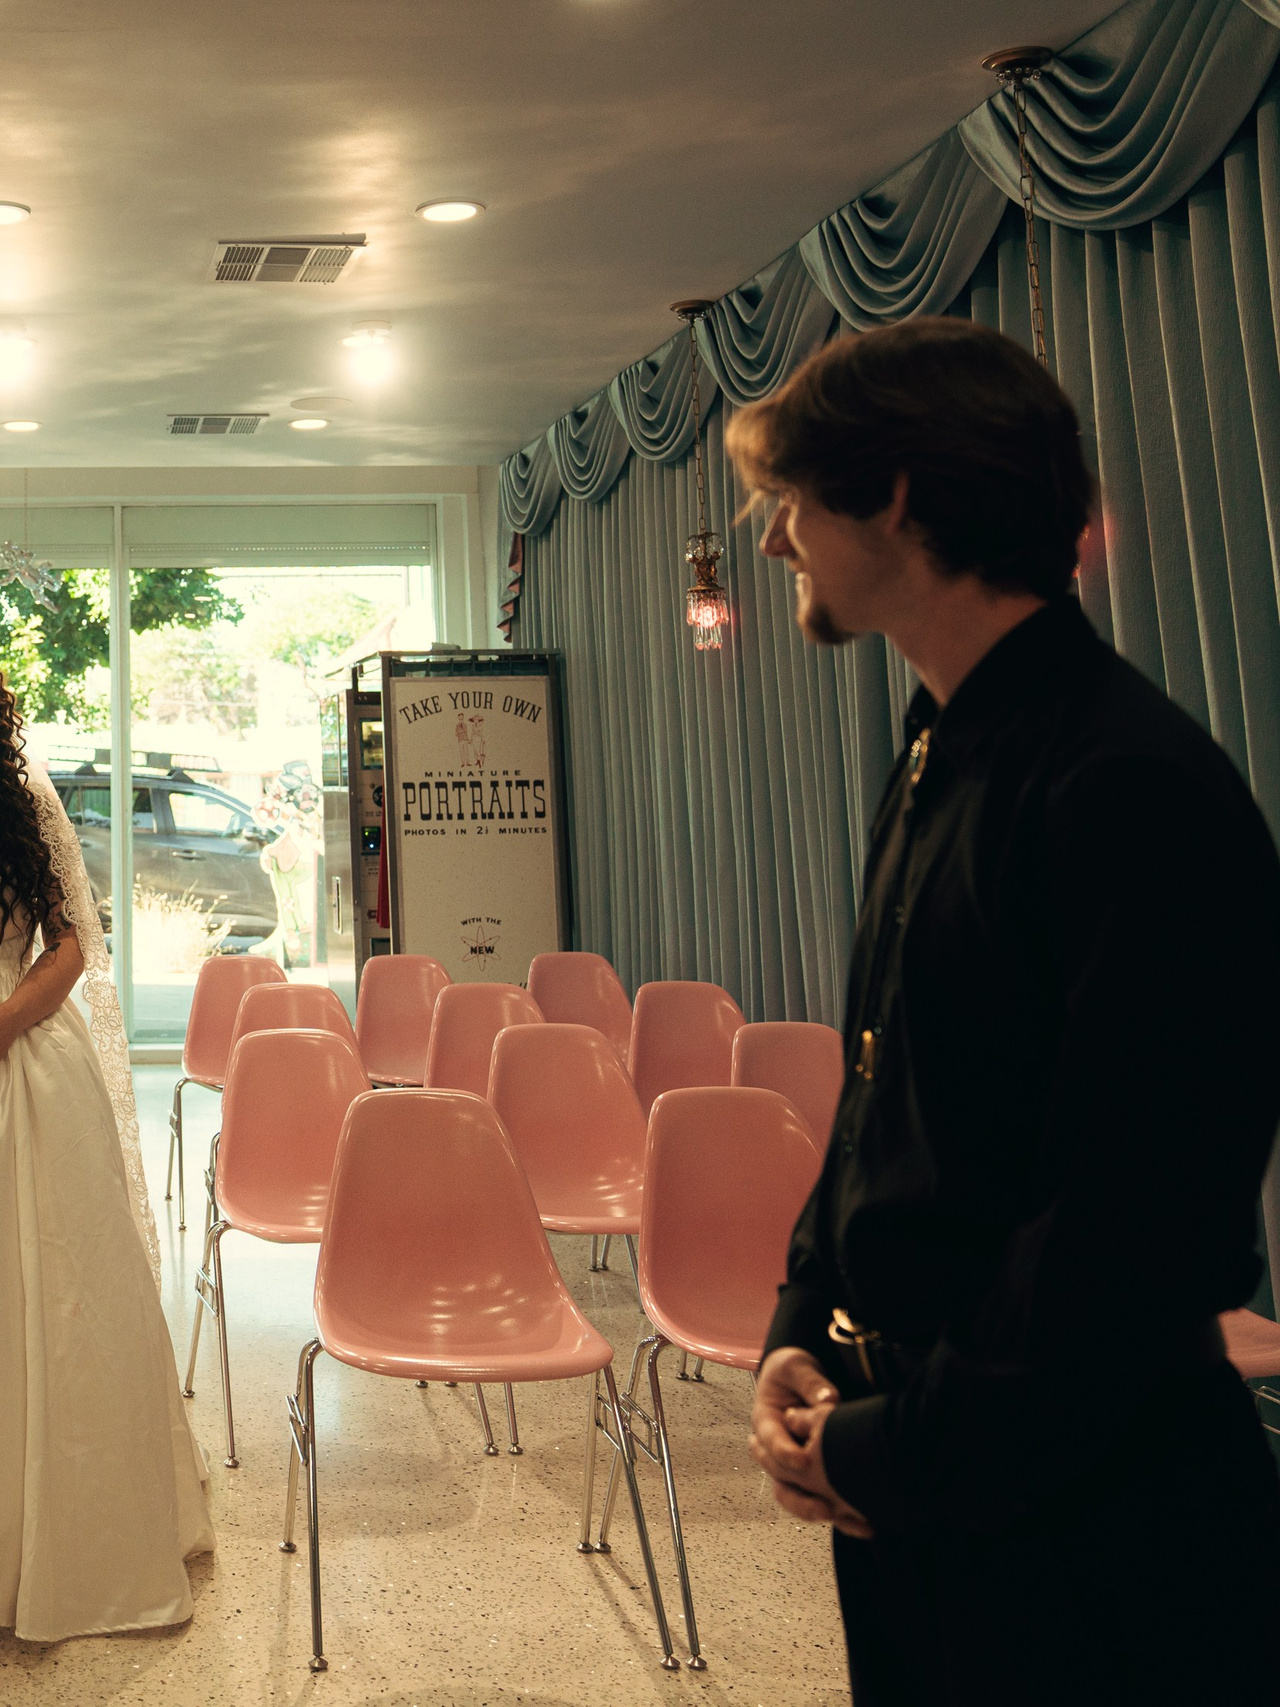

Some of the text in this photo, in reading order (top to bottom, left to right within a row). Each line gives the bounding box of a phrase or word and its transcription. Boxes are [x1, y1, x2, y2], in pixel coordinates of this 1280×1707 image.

[399, 691, 543, 724] TAKE YOUR OWN
[424, 770, 521, 778] MINIATURE
[402, 779, 546, 821] PORTRAITS
[404, 828, 446, 837] PHOTOS
[455, 828, 467, 836] IN
[498, 827, 547, 835] MINUTES
[461, 917, 502, 926] WITH THE
[470, 946, 495, 954] NEW
